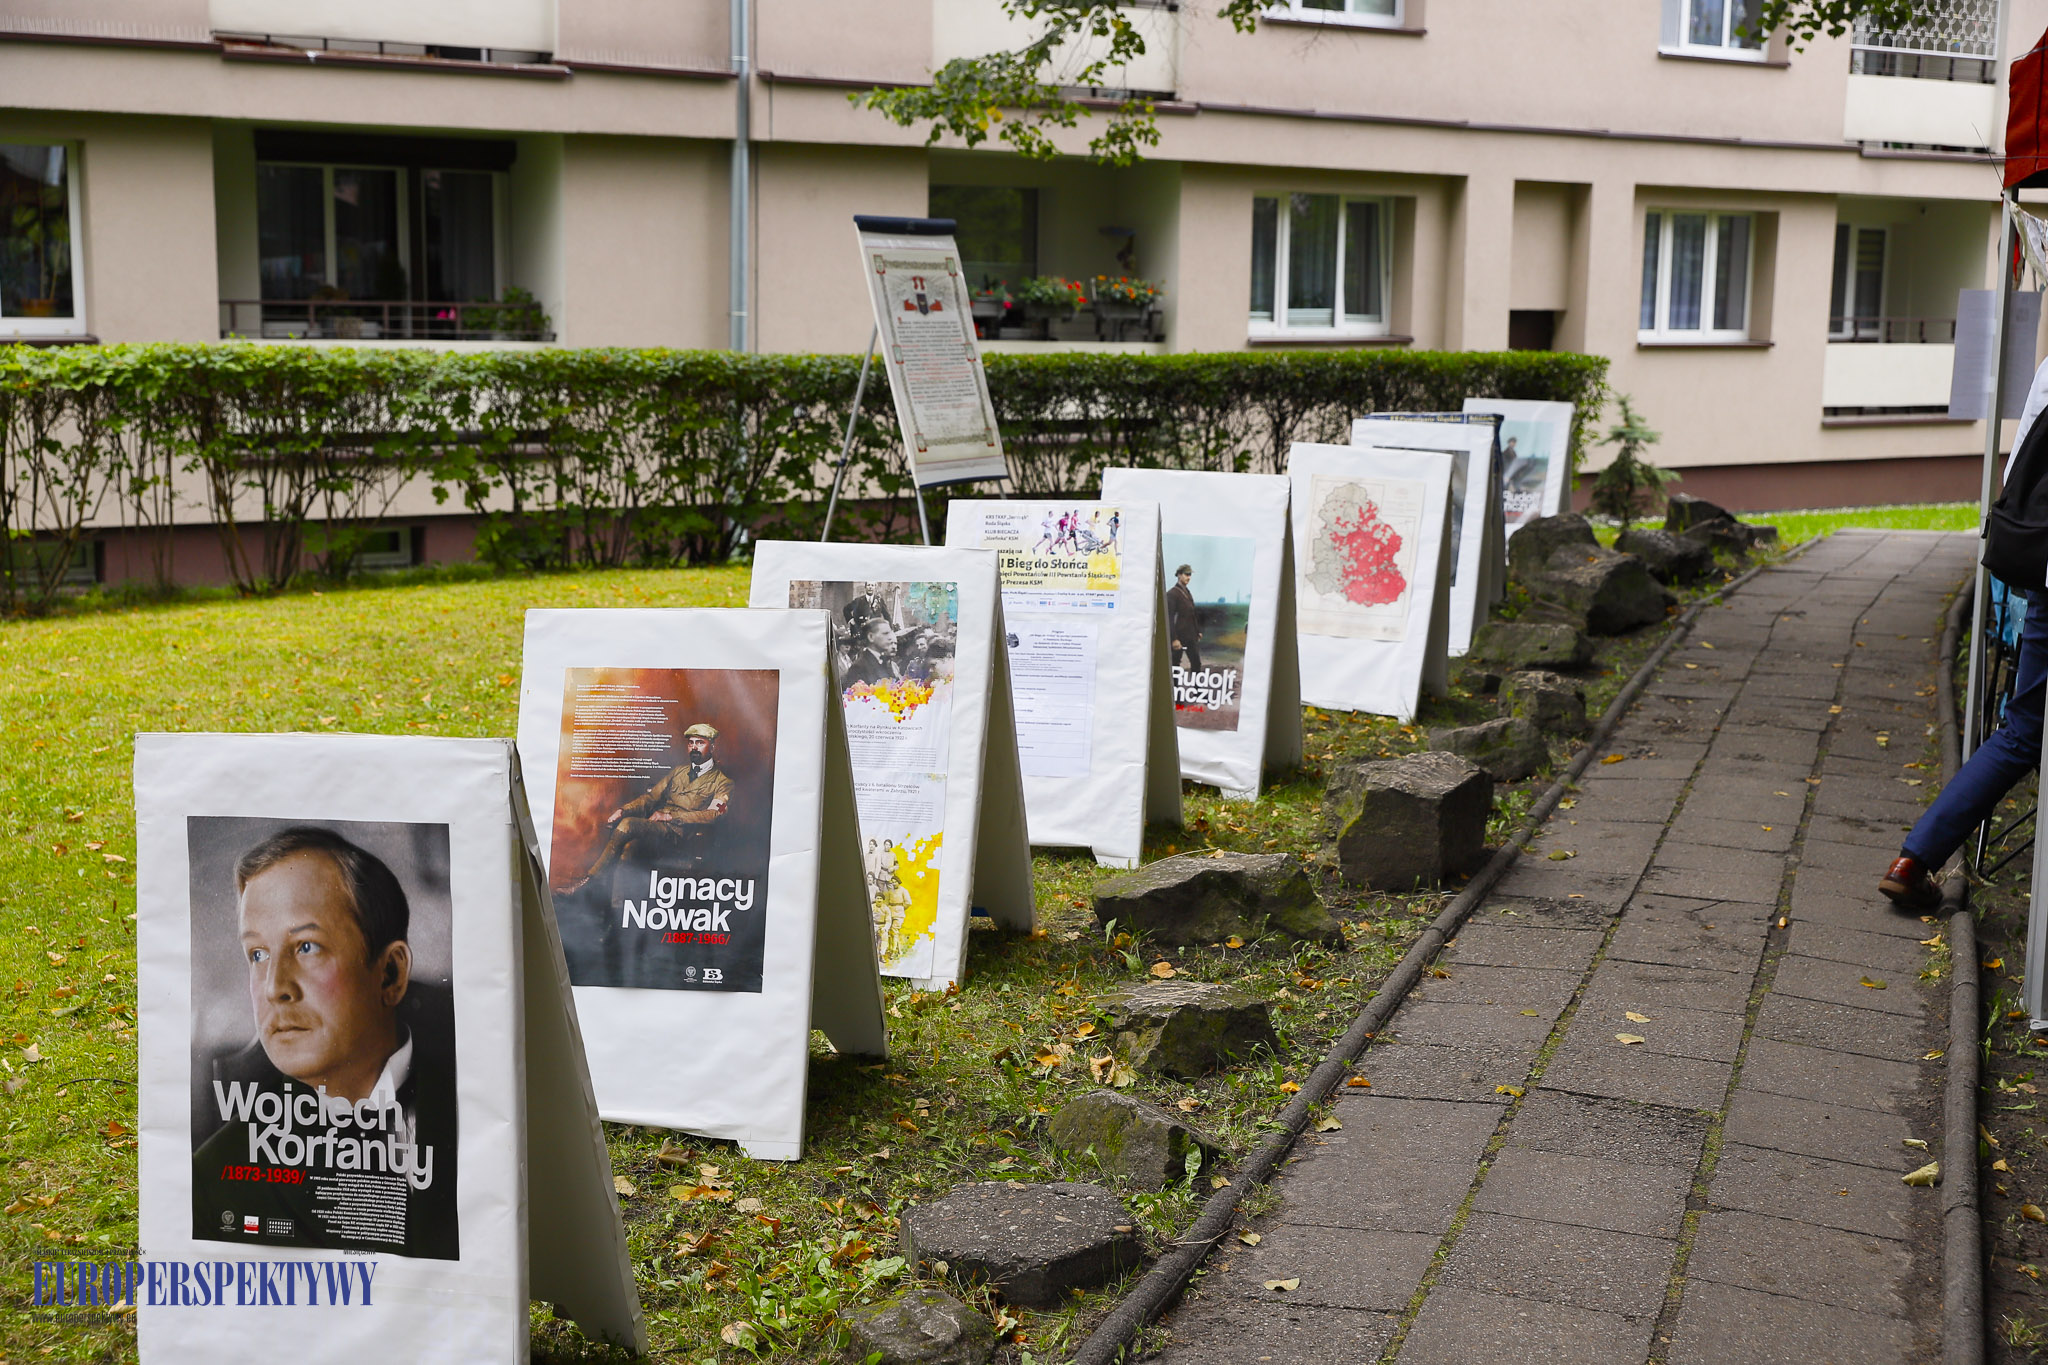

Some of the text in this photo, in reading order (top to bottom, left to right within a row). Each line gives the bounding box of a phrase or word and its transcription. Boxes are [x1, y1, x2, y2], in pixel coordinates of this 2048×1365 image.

[1007, 558, 1033, 571] Bieg
[1035, 558, 1049, 569] do
[1050, 558, 1088, 569] Słońca
[1172, 666, 1237, 689] Rudolf
[649, 870, 755, 911] Ignacy
[622, 900, 732, 932] Nowak
[661, 932, 731, 945] /1887-1966/
[213, 1080, 402, 1137] Wojciech
[249, 1123, 434, 1190] Korfanty
[220, 1165, 306, 1187] /1873-1939/
